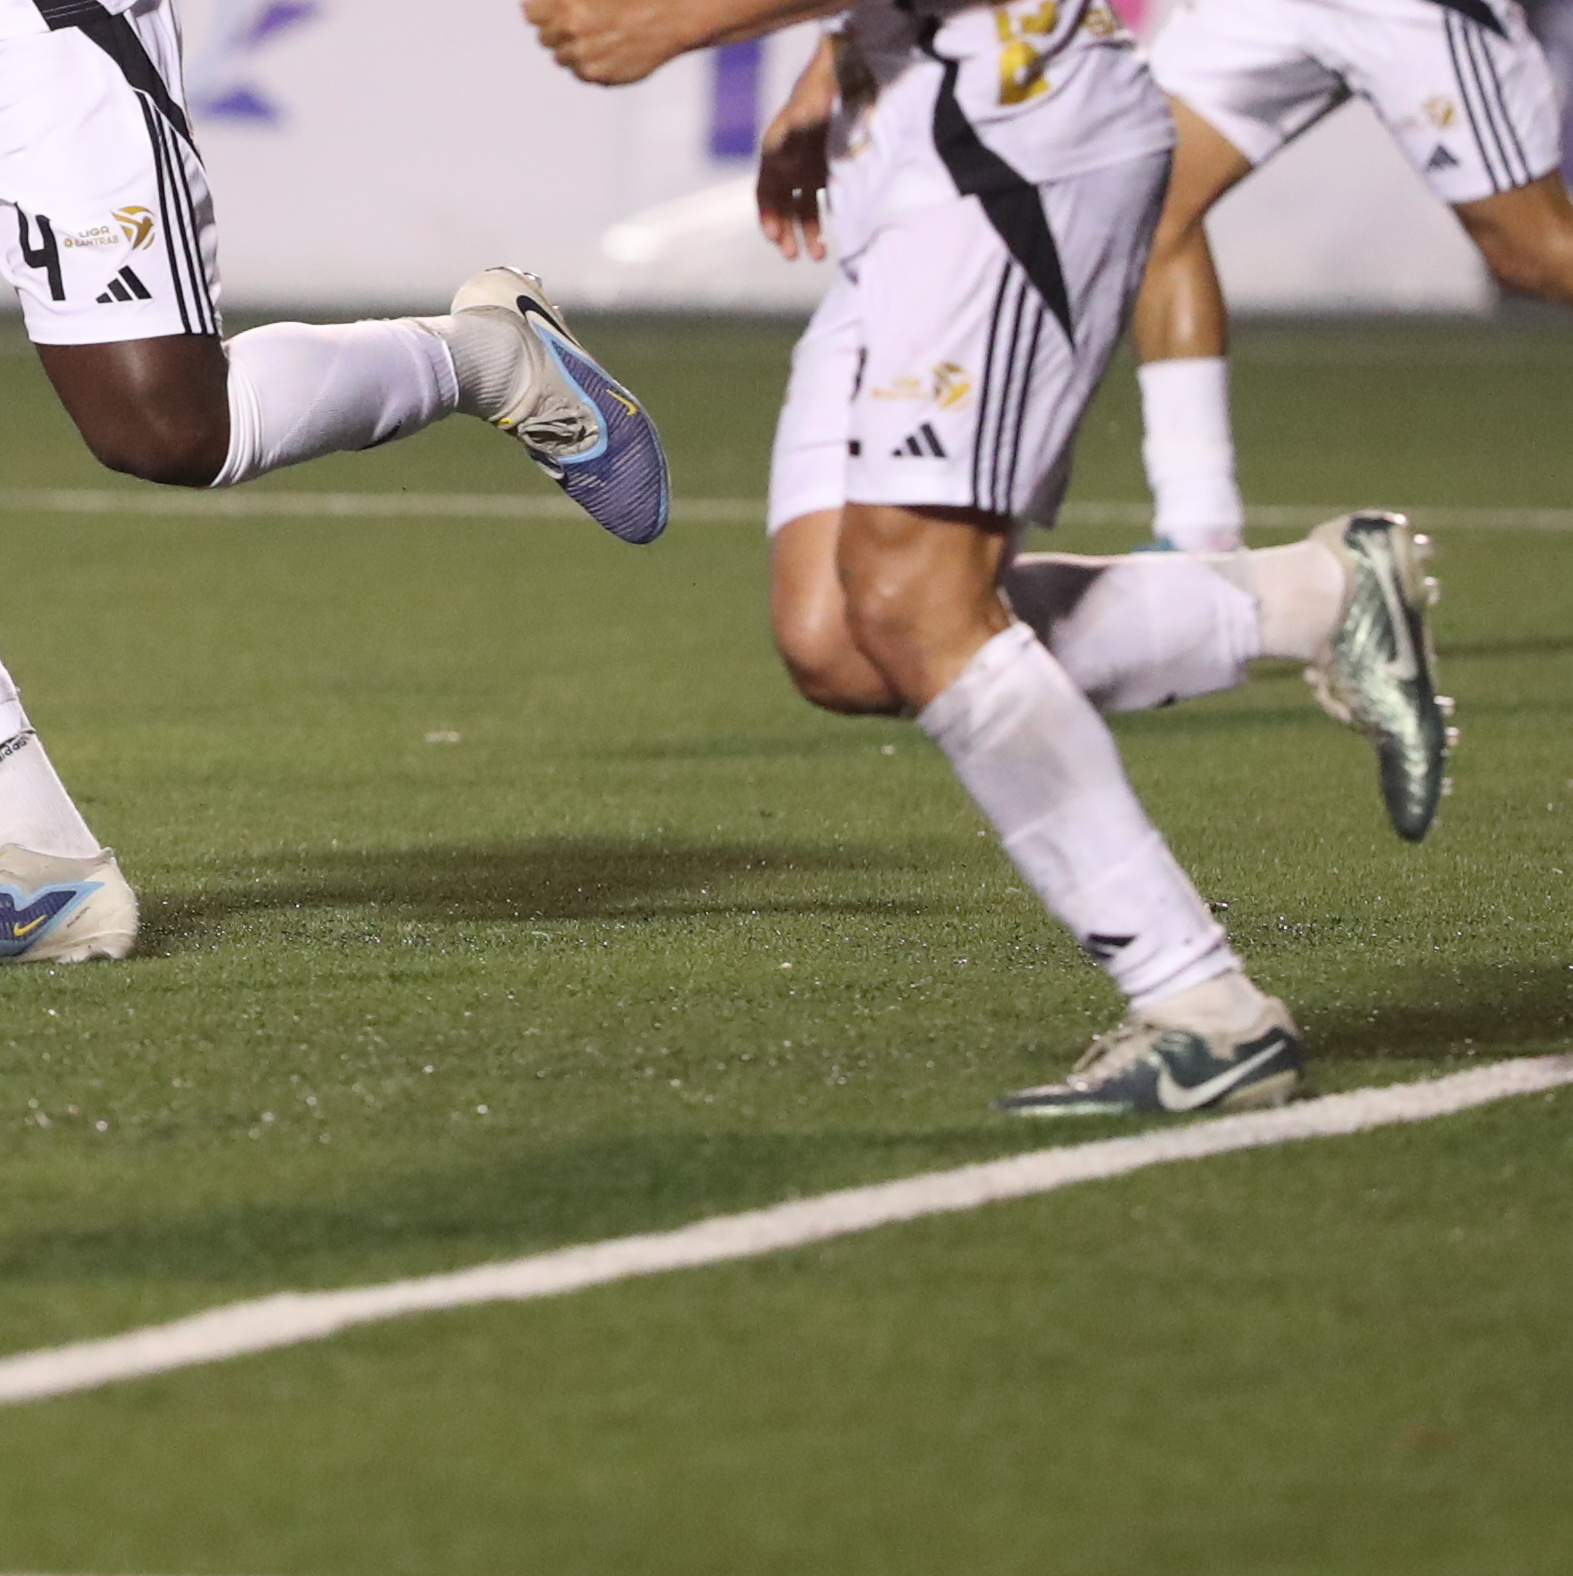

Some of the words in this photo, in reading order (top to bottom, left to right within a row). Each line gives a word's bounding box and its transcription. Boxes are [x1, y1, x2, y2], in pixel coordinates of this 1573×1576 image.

[78, 225, 110, 238] LIGA
[74, 235, 119, 247] BANTRAB
[14, 202, 66, 301] 4
